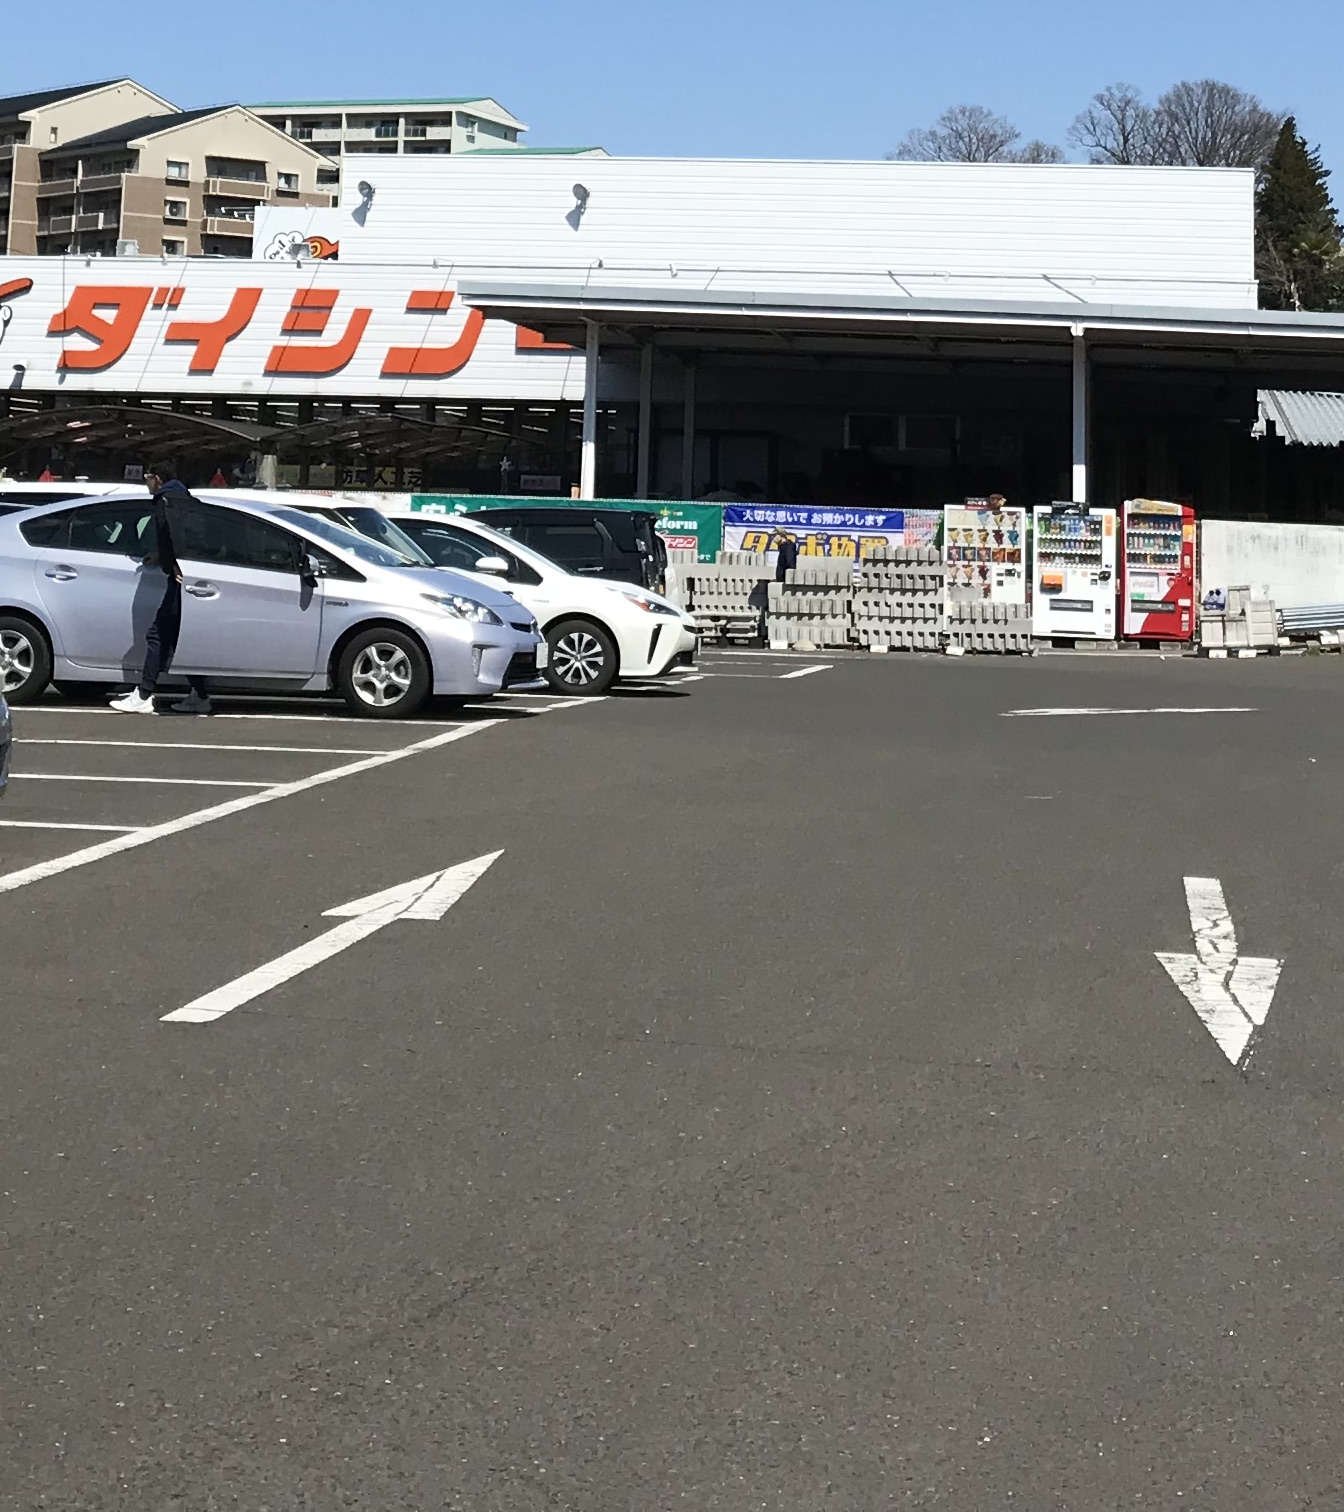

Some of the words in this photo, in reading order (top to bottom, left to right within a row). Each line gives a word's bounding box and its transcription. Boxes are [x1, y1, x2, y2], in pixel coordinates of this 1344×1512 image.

[47, 285, 485, 375] ダイシン
[654, 517, 698, 530] eform
[810, 512, 886, 527] お預かりします
